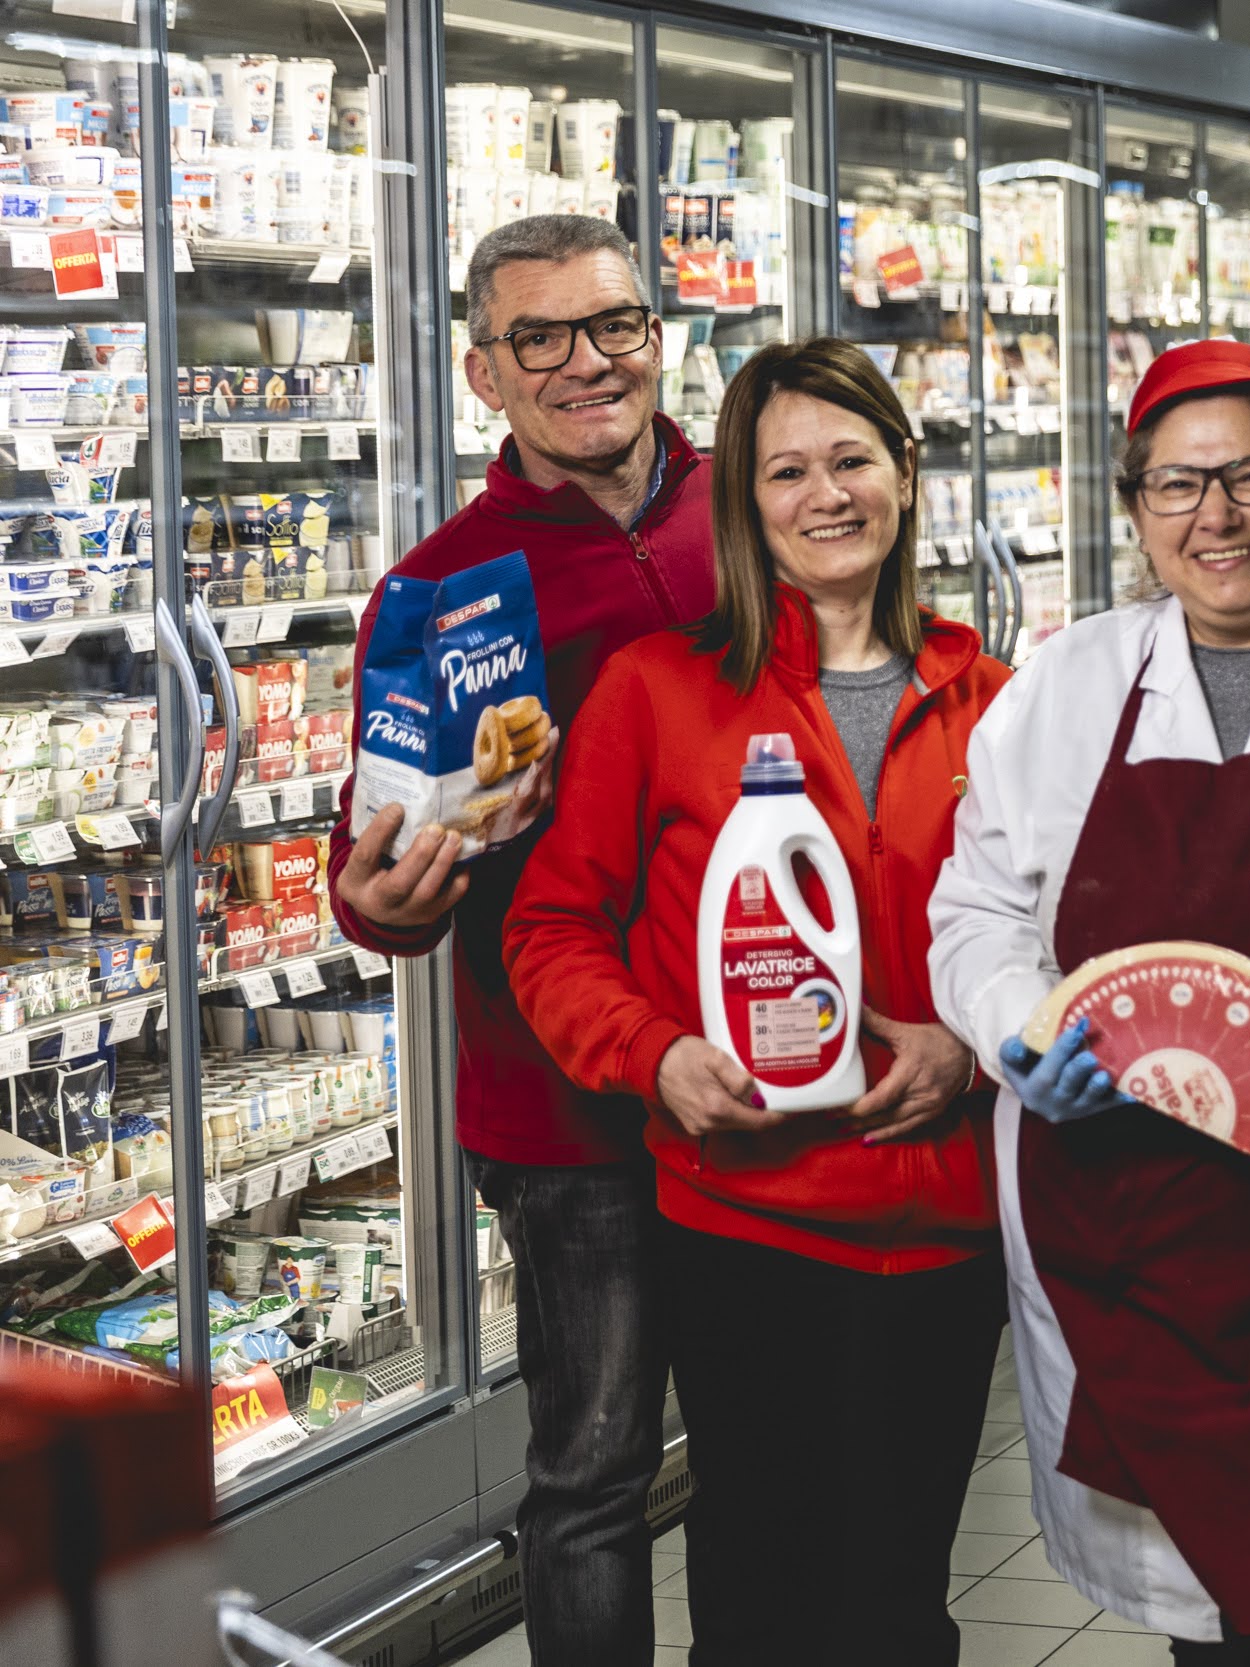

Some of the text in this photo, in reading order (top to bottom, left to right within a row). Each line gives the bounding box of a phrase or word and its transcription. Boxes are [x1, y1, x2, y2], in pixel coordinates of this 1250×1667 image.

[54, 252, 97, 269] OFFERTA
[443, 601, 487, 628] DESPAR
[467, 635, 514, 661] FROLLINI CON
[441, 643, 527, 712] Panna
[258, 682, 292, 701] YOMO
[258, 740, 293, 758] YOMO
[310, 731, 343, 749] YOMO
[274, 857, 316, 877] YOMO
[280, 912, 317, 934] YOMO
[228, 925, 264, 946] YOMO
[733, 928, 779, 938] DESPAR
[746, 949, 793, 960] DETERSIVO
[724, 957, 816, 977] LAVATRICE
[748, 975, 794, 988] COLOR
[755, 1003, 767, 1014] 40
[755, 1025, 767, 1036] 30
[127, 1220, 168, 1248] OFFERTA
